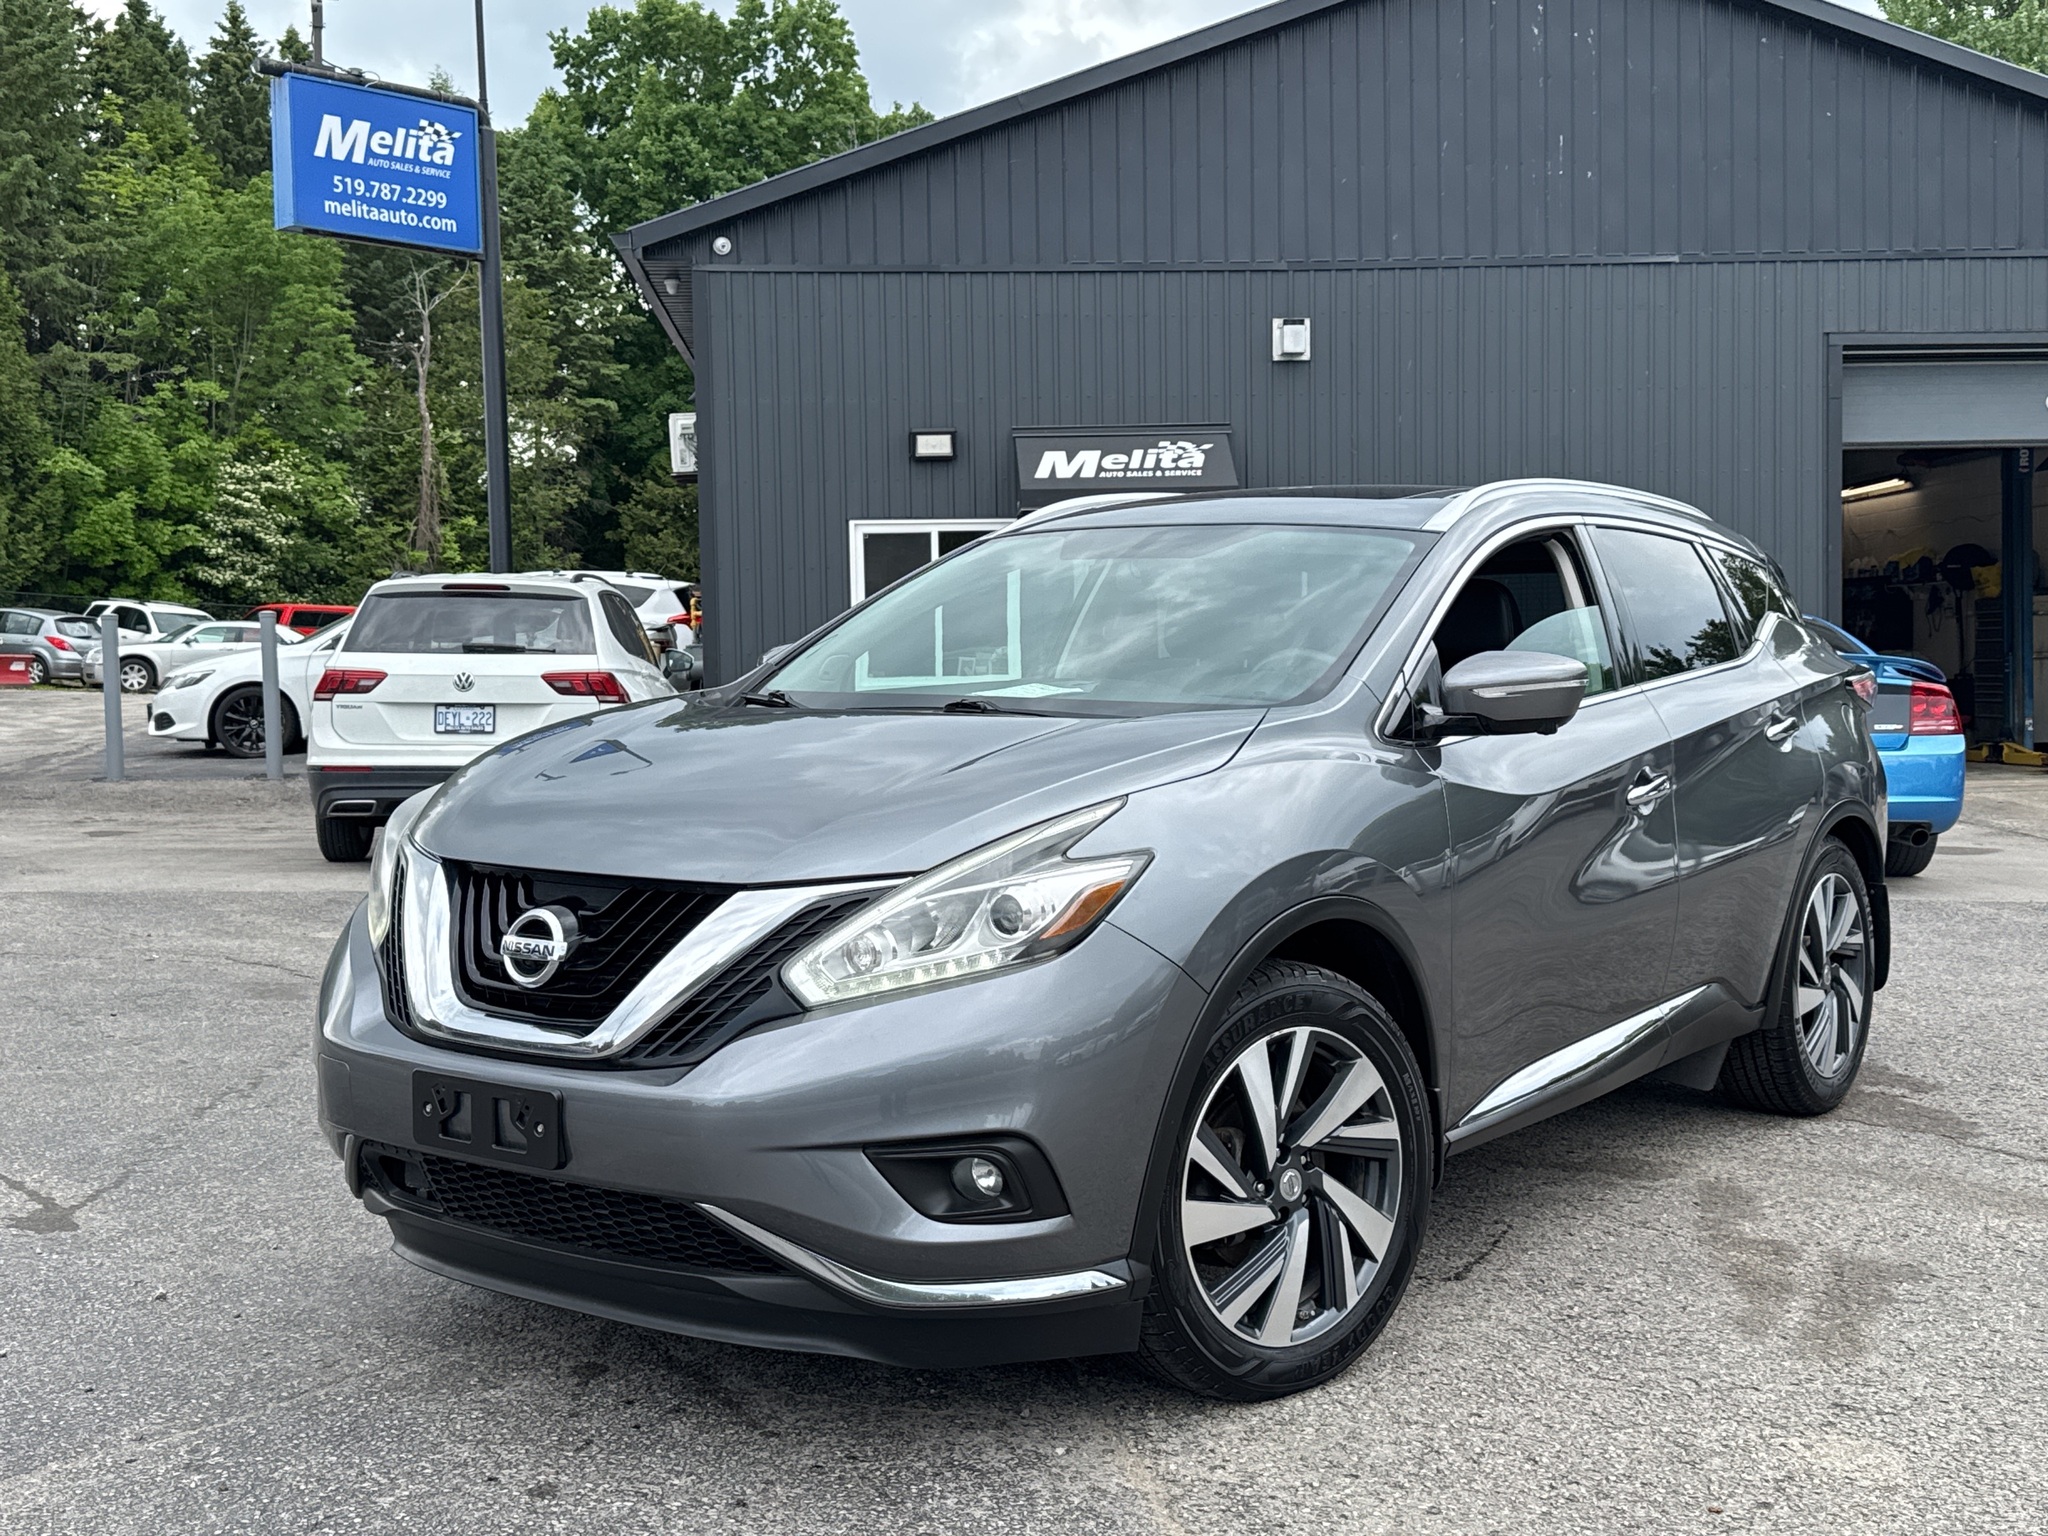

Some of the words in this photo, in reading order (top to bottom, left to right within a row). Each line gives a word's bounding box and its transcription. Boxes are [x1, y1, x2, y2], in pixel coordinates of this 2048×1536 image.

[313, 114, 457, 167] Melita
[367, 157, 390, 169] AUTO
[390, 161, 414, 173] SALES
[414, 165, 421, 174] &
[421, 166, 452, 179] SERVICE
[333, 175, 448, 209] 519.787.2299
[324, 199, 458, 233] melitaauto.com
[1034, 448, 1206, 479] Melita
[1126, 470, 1154, 478] SALES
[1164, 469, 1203, 477] SERVICE
[502, 940, 555, 957] NISSAN
[1202, 992, 1308, 1077] ASSURANCE
